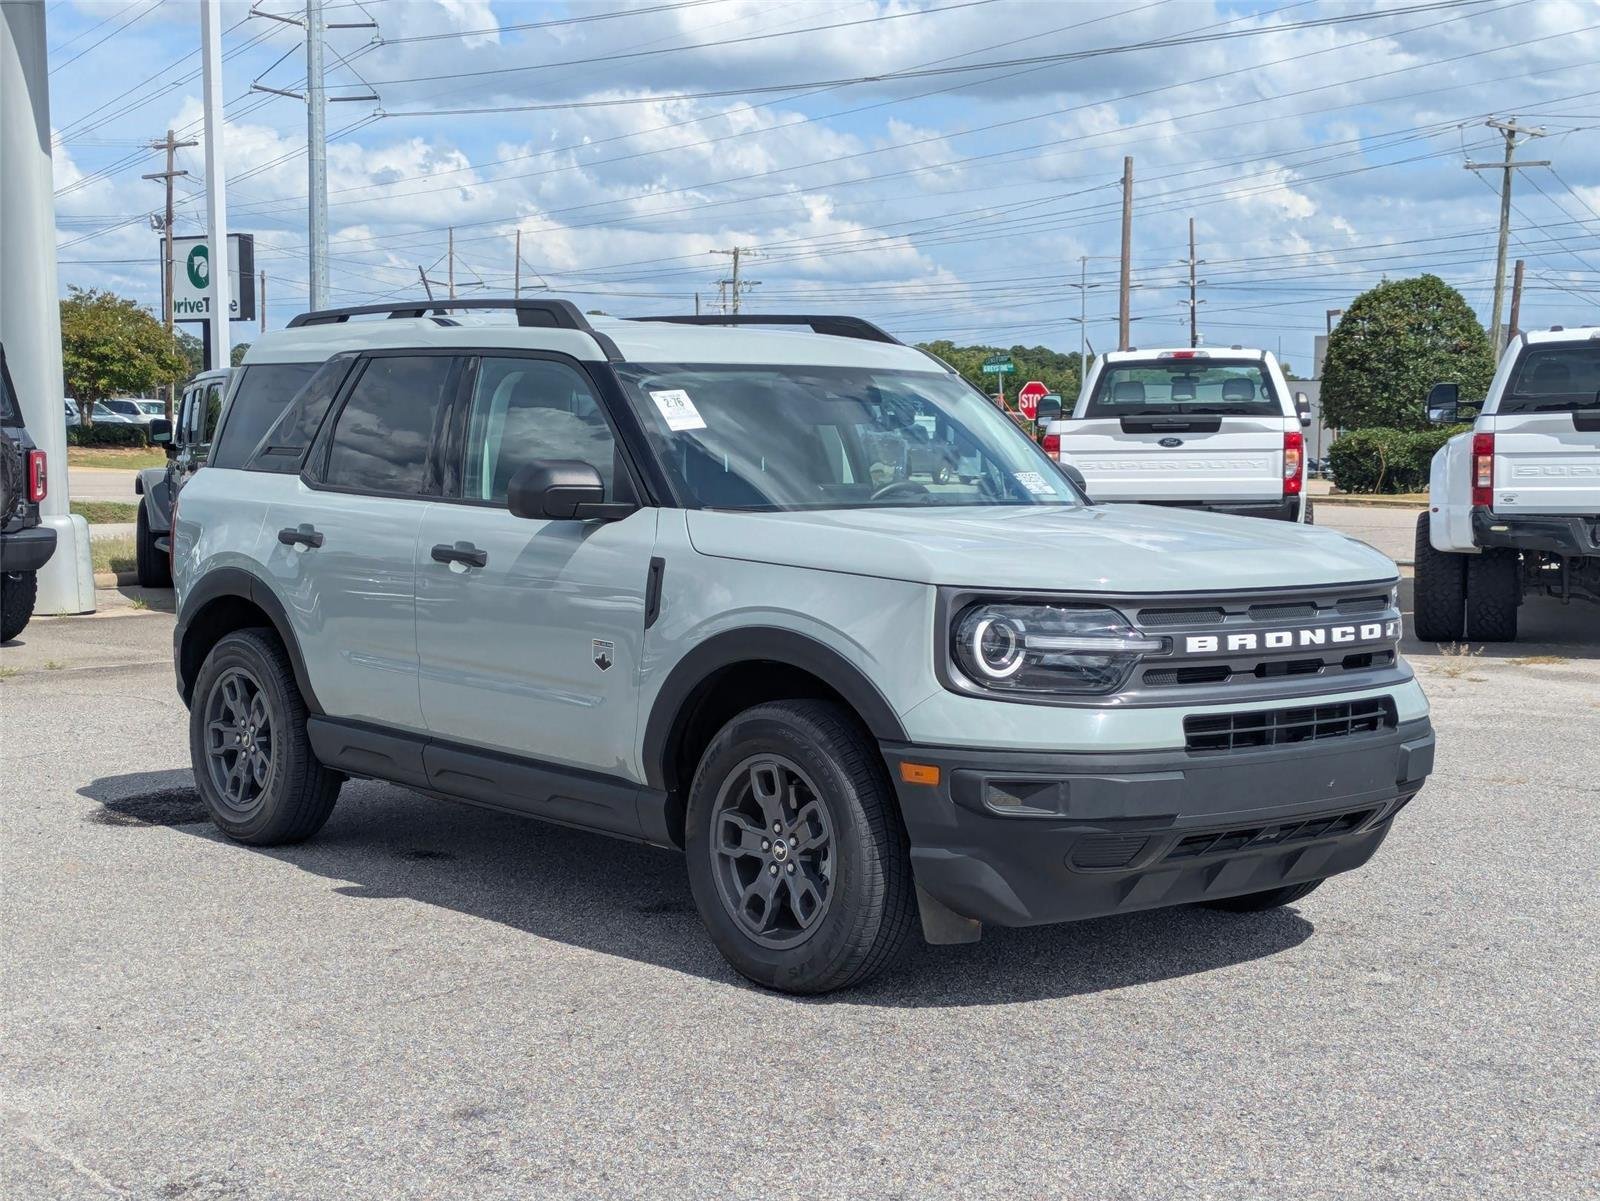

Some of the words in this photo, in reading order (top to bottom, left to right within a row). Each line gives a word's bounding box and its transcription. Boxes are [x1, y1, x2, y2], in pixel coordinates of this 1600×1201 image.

[1079, 460, 1178, 470] SUPER
[1186, 459, 1265, 470] DUTY
[1516, 464, 1600, 476] SUP
[1186, 623, 1382, 653] BRONCO
